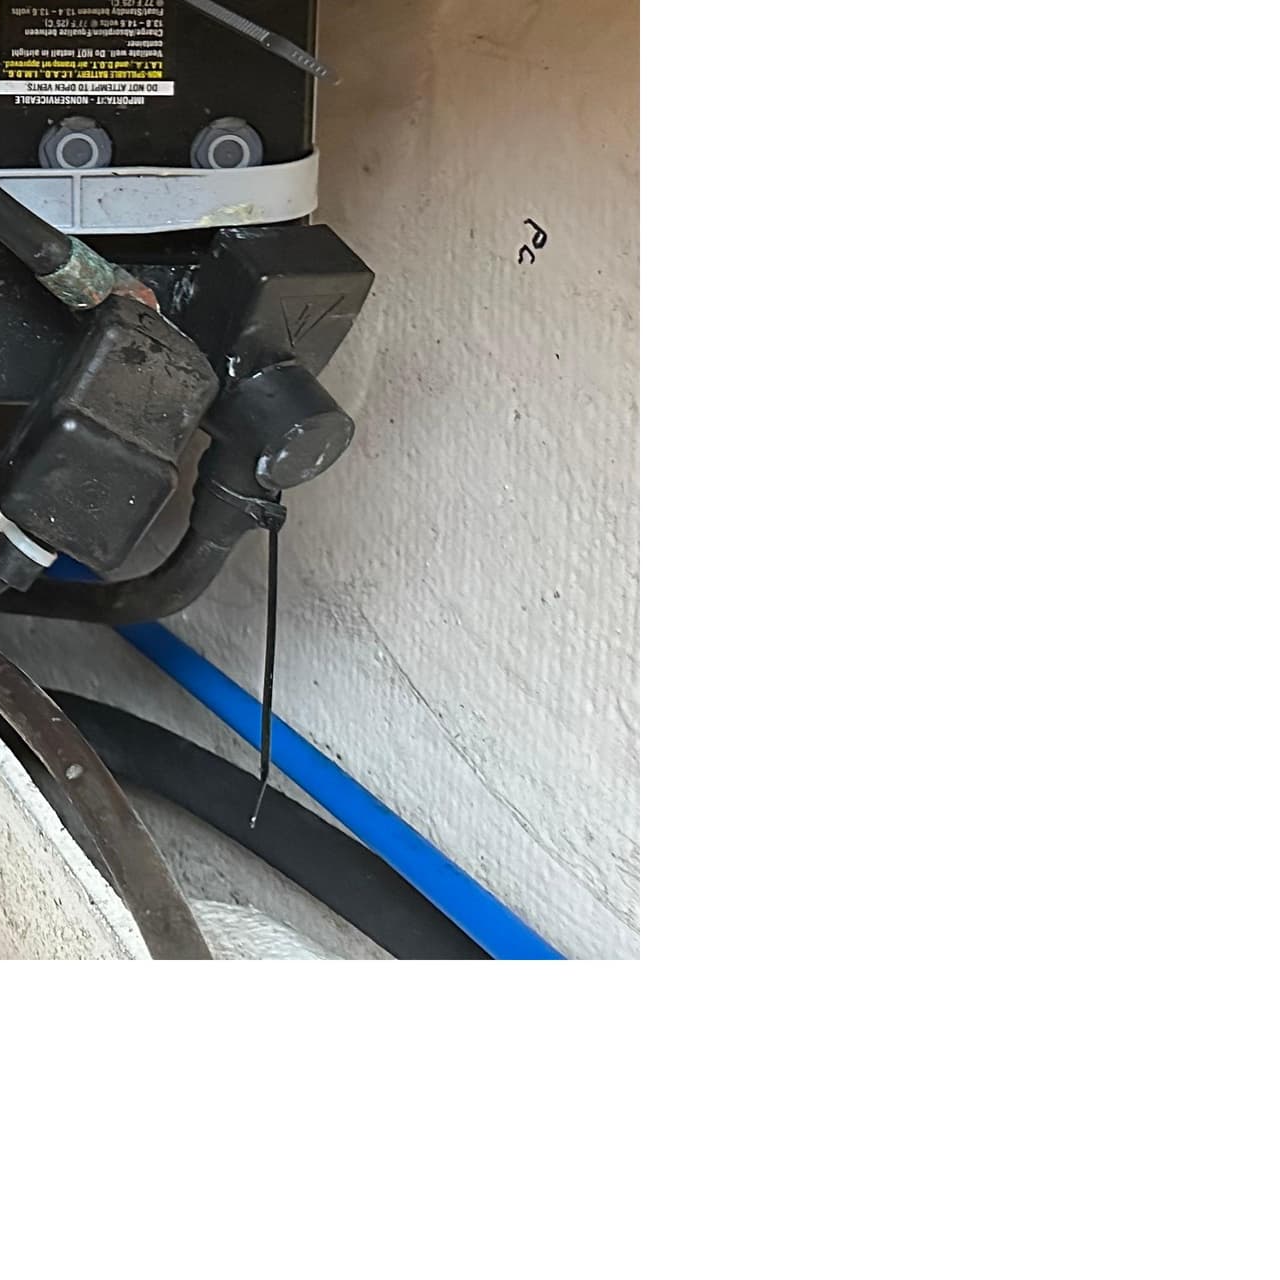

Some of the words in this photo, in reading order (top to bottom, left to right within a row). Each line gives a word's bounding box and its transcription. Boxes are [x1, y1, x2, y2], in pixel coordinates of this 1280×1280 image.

[55, 83, 76, 91] OPEN
[91, 83, 125, 91] ATTEMPT
[128, 83, 144, 91] NOT
[15, 96, 88, 104] NONSERVICEABLE
